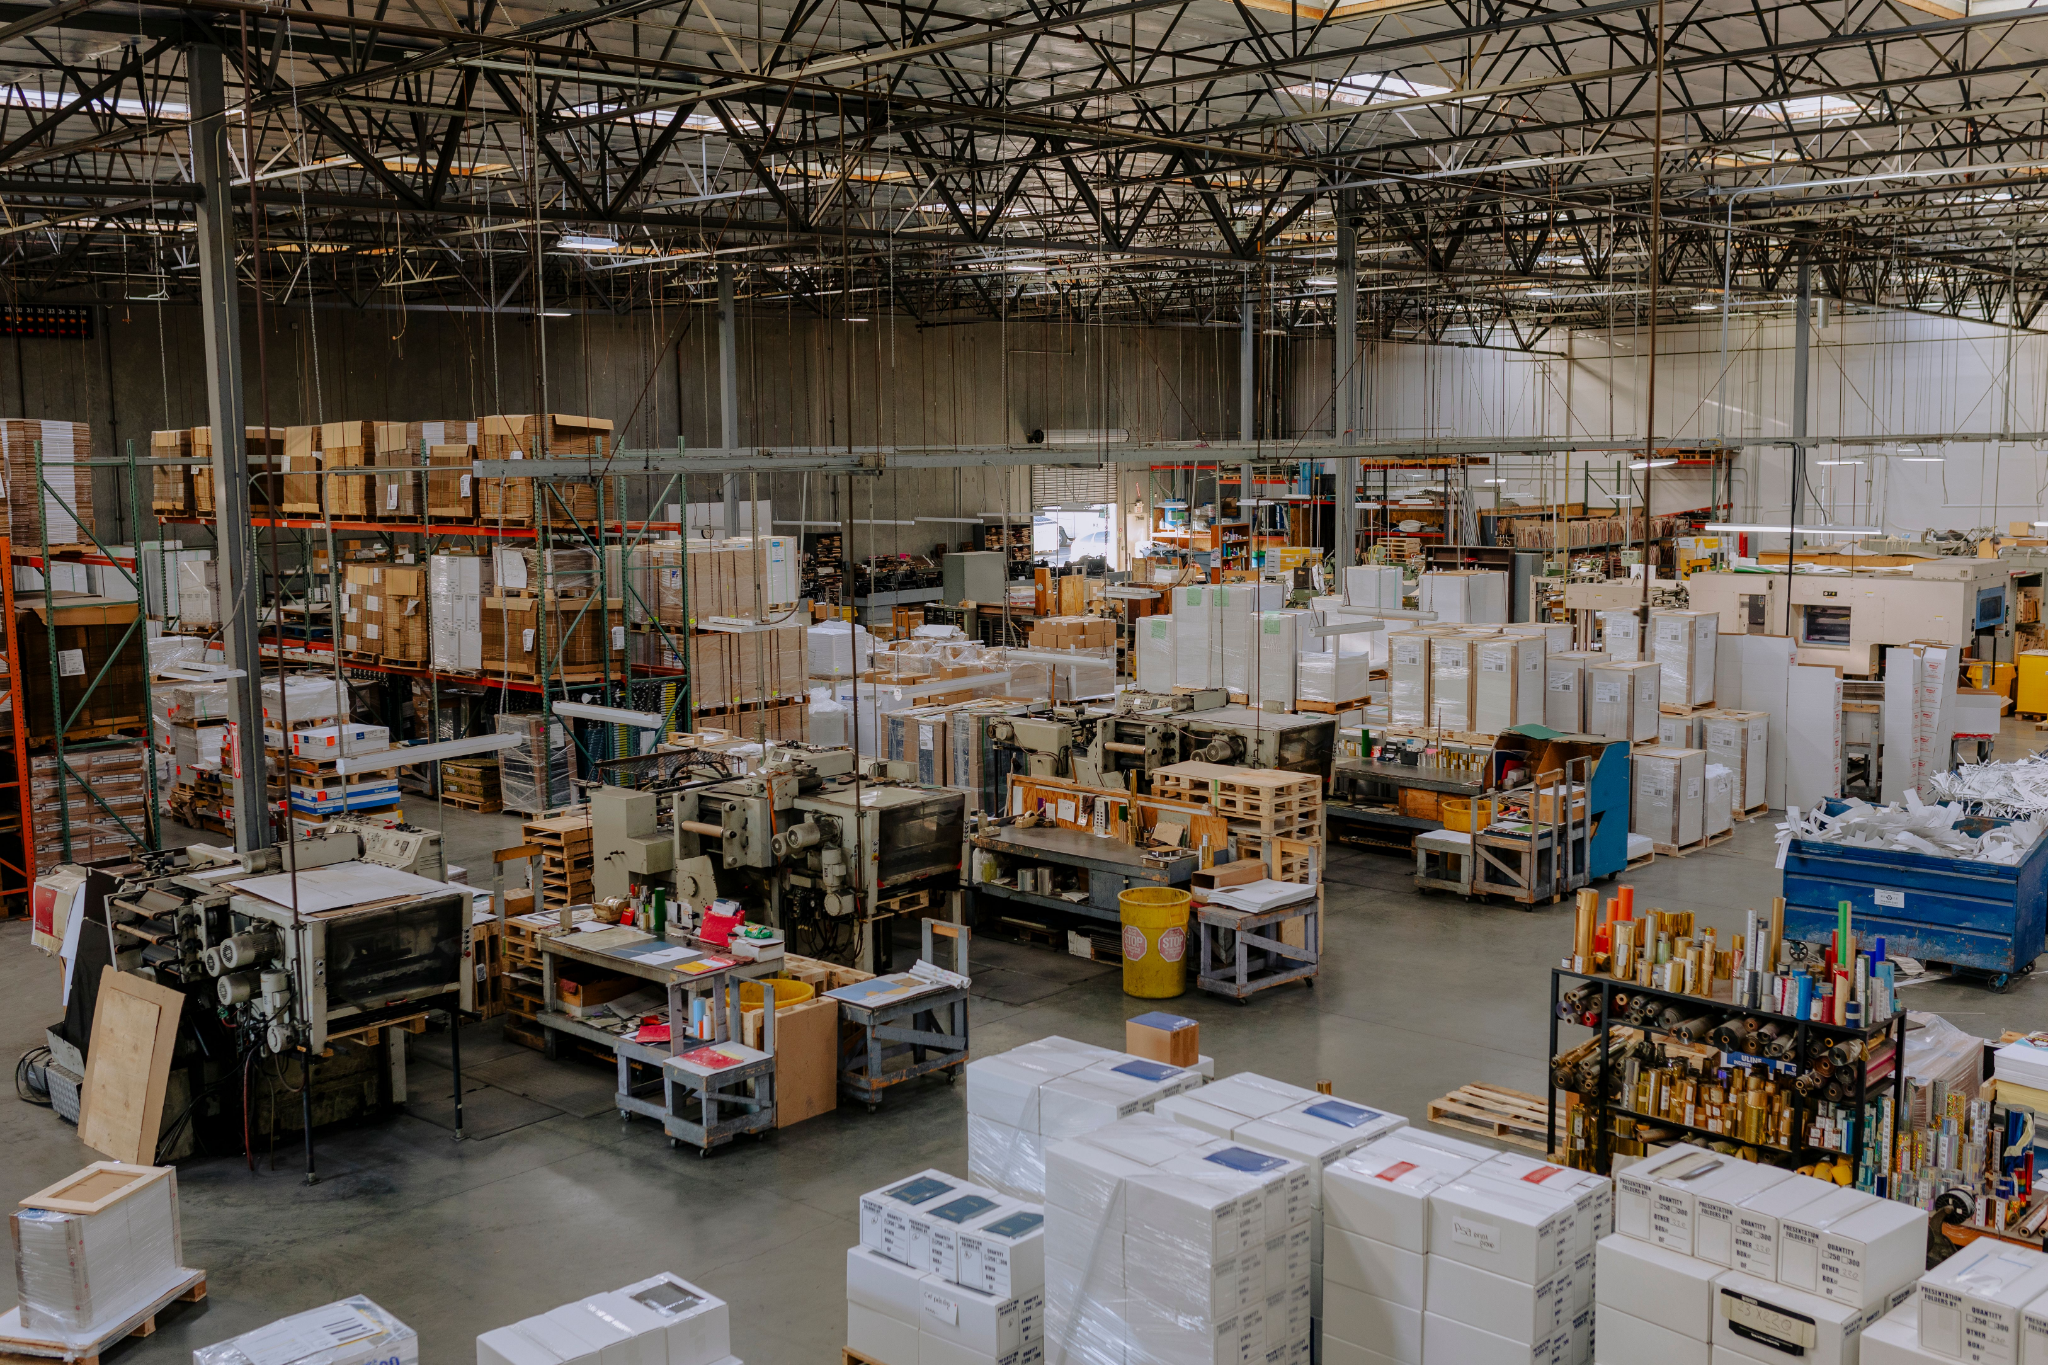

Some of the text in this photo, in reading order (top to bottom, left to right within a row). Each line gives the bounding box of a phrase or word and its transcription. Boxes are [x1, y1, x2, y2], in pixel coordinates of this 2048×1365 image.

[1125, 934, 1143, 947] STOP
[1162, 935, 1184, 949] STOP
[1741, 1055, 1762, 1063] ULINE
[1620, 1178, 1651, 1191] PRESENTATION
[1622, 1185, 1640, 1194] FOLDERS
[1659, 1195, 1682, 1206] QUANTITY
[1660, 1203, 1688, 1216] 250 300
[1699, 1201, 1733, 1215] PRESENTATION
[1701, 1208, 1721, 1219] FOLDERS
[1654, 1214, 1669, 1223] OTHER
[1740, 1219, 1766, 1231] QUANTITY
[1742, 1228, 1772, 1241] 250 300
[1783, 1224, 1819, 1239] PRESENTATION
[1786, 1231, 1807, 1243] FOLDERS
[1735, 1238, 1752, 1248] OTHER
[1827, 1243, 1854, 1256] QUANTITY
[1829, 1253, 1860, 1267] 250 300
[1821, 1263, 1839, 1274] OTHER
[1921, 1286, 1962, 1302] PRESENTATION
[1924, 1294, 1948, 1306] FOLDERS
[1971, 1306, 2002, 1321] QUANTITY
[1974, 1317, 2009, 1332] 250 300
[1966, 1328, 1986, 1339] OTHER
